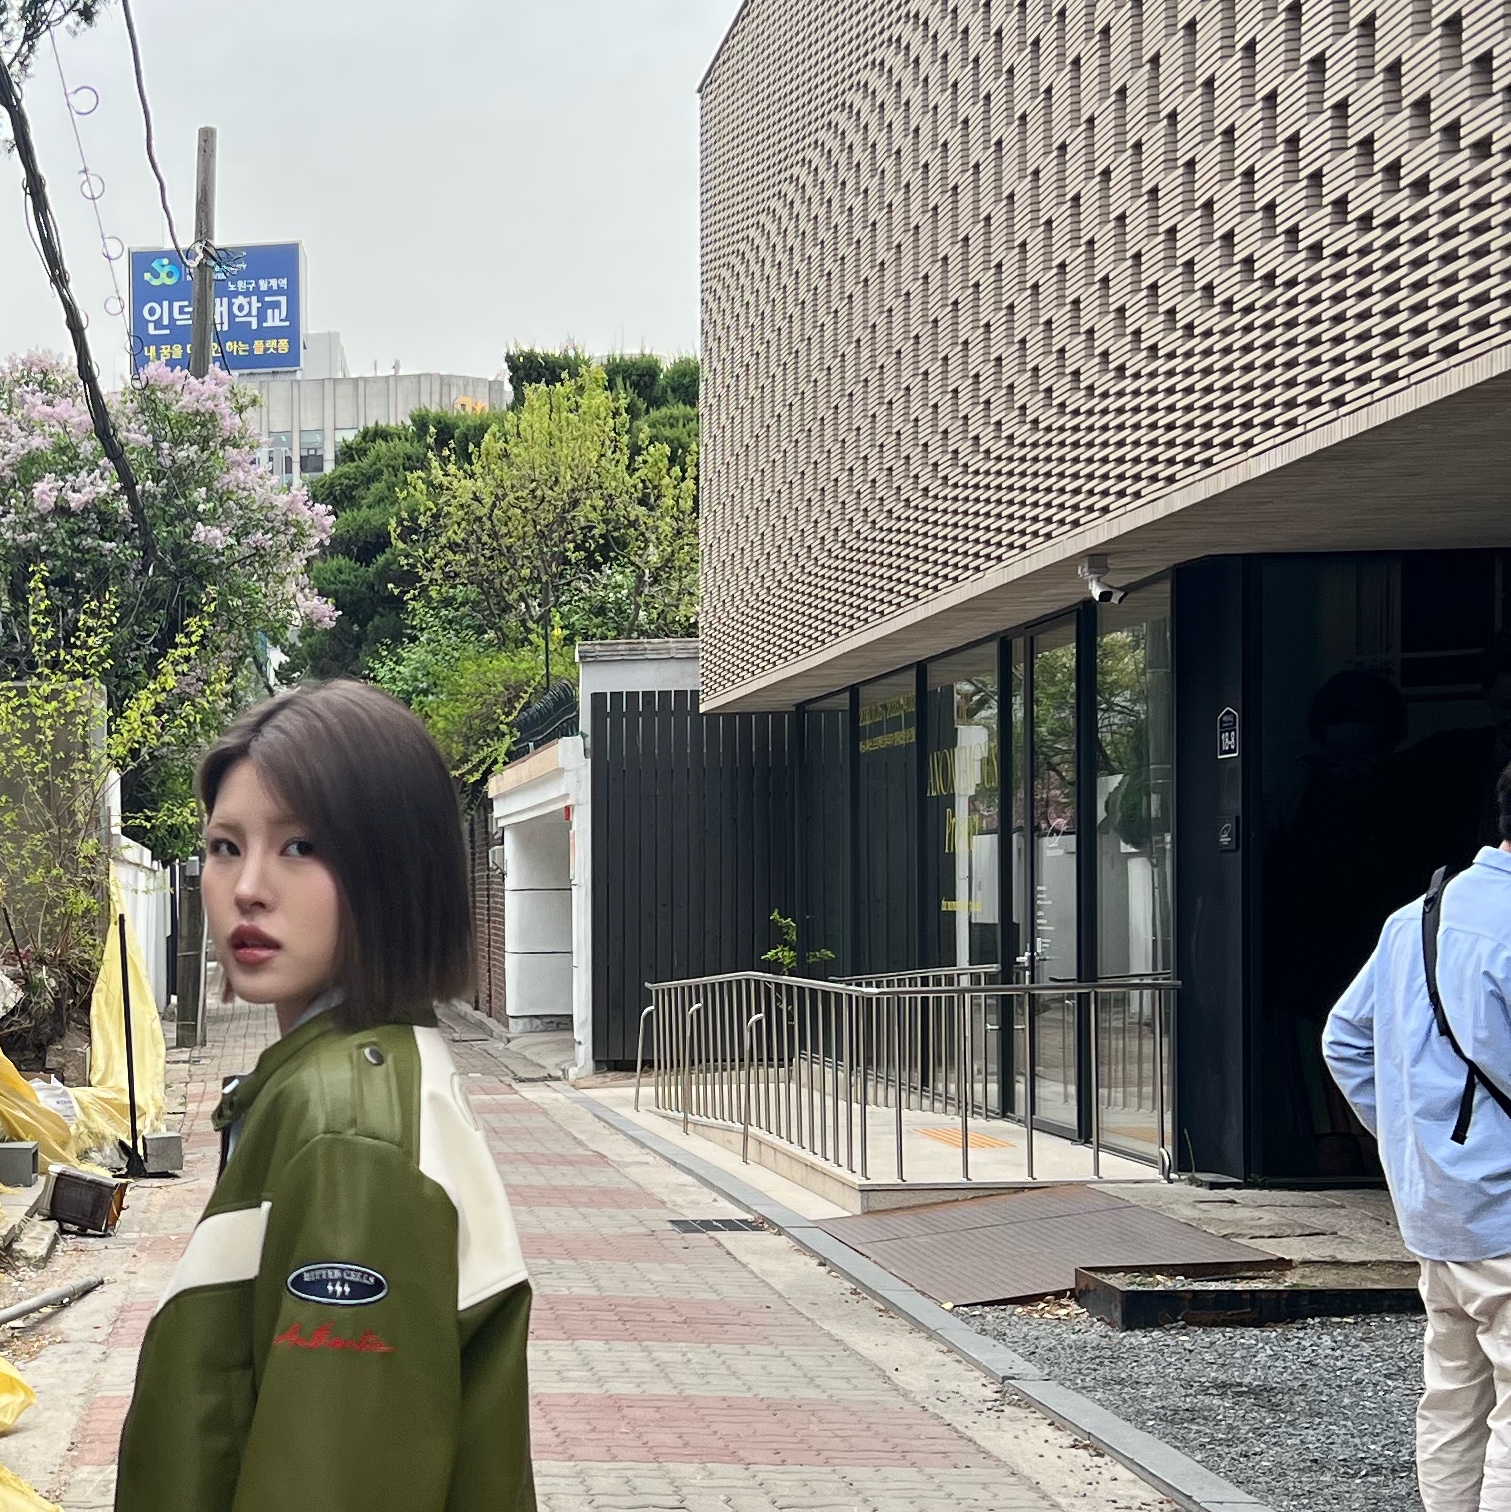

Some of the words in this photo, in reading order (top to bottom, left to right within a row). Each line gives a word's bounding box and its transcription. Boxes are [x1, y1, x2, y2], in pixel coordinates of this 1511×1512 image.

[227, 279, 256, 292] 노원구
[258, 277, 288, 291] 월계역
[225, 340, 250, 356] 하는
[253, 338, 290, 355] 플랫폼
